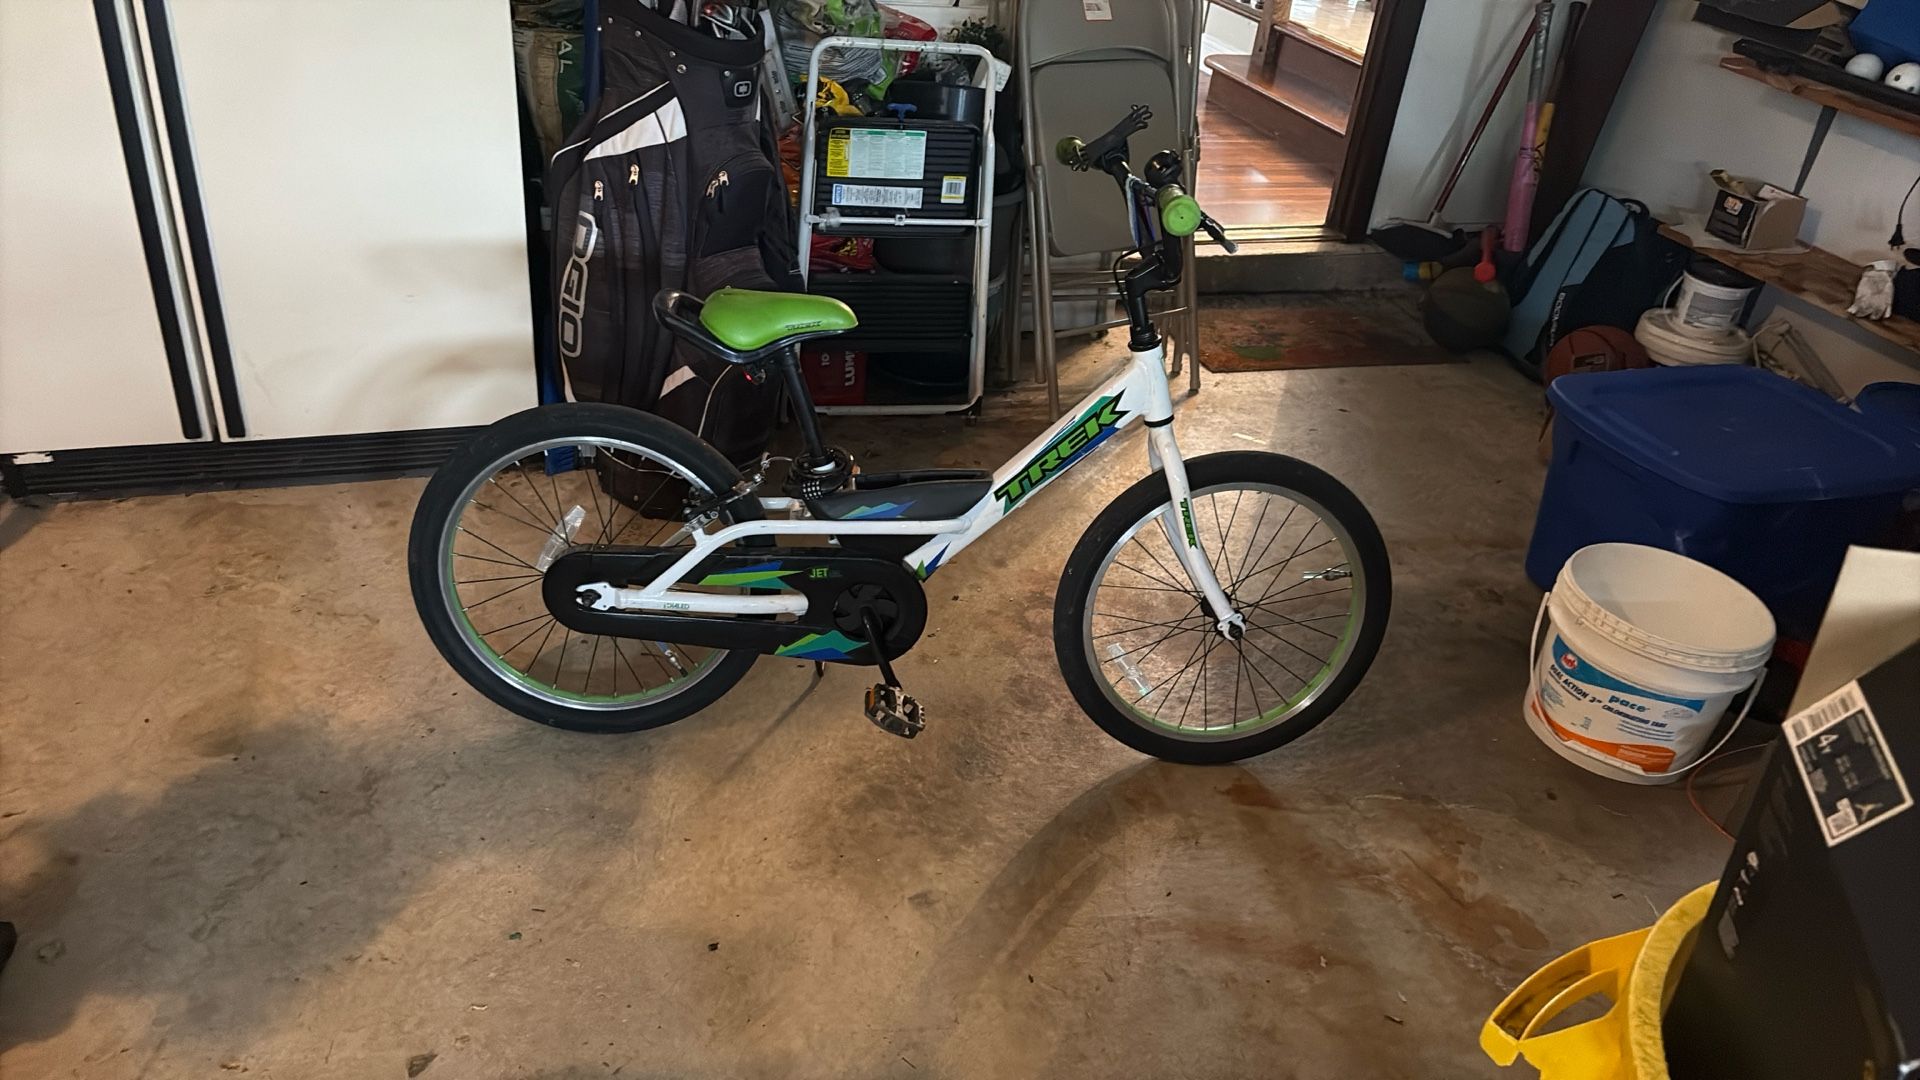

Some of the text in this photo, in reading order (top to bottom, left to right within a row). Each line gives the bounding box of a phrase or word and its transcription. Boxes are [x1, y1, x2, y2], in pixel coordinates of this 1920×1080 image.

[559, 210, 598, 358] OGIO
[845, 350, 855, 387] LUM
[994, 387, 1132, 502] TREK
[1179, 497, 1199, 549] TREK
[809, 567, 830, 579] JET
[1562, 679, 1589, 698] ACTION
[1608, 695, 1647, 712] pace
